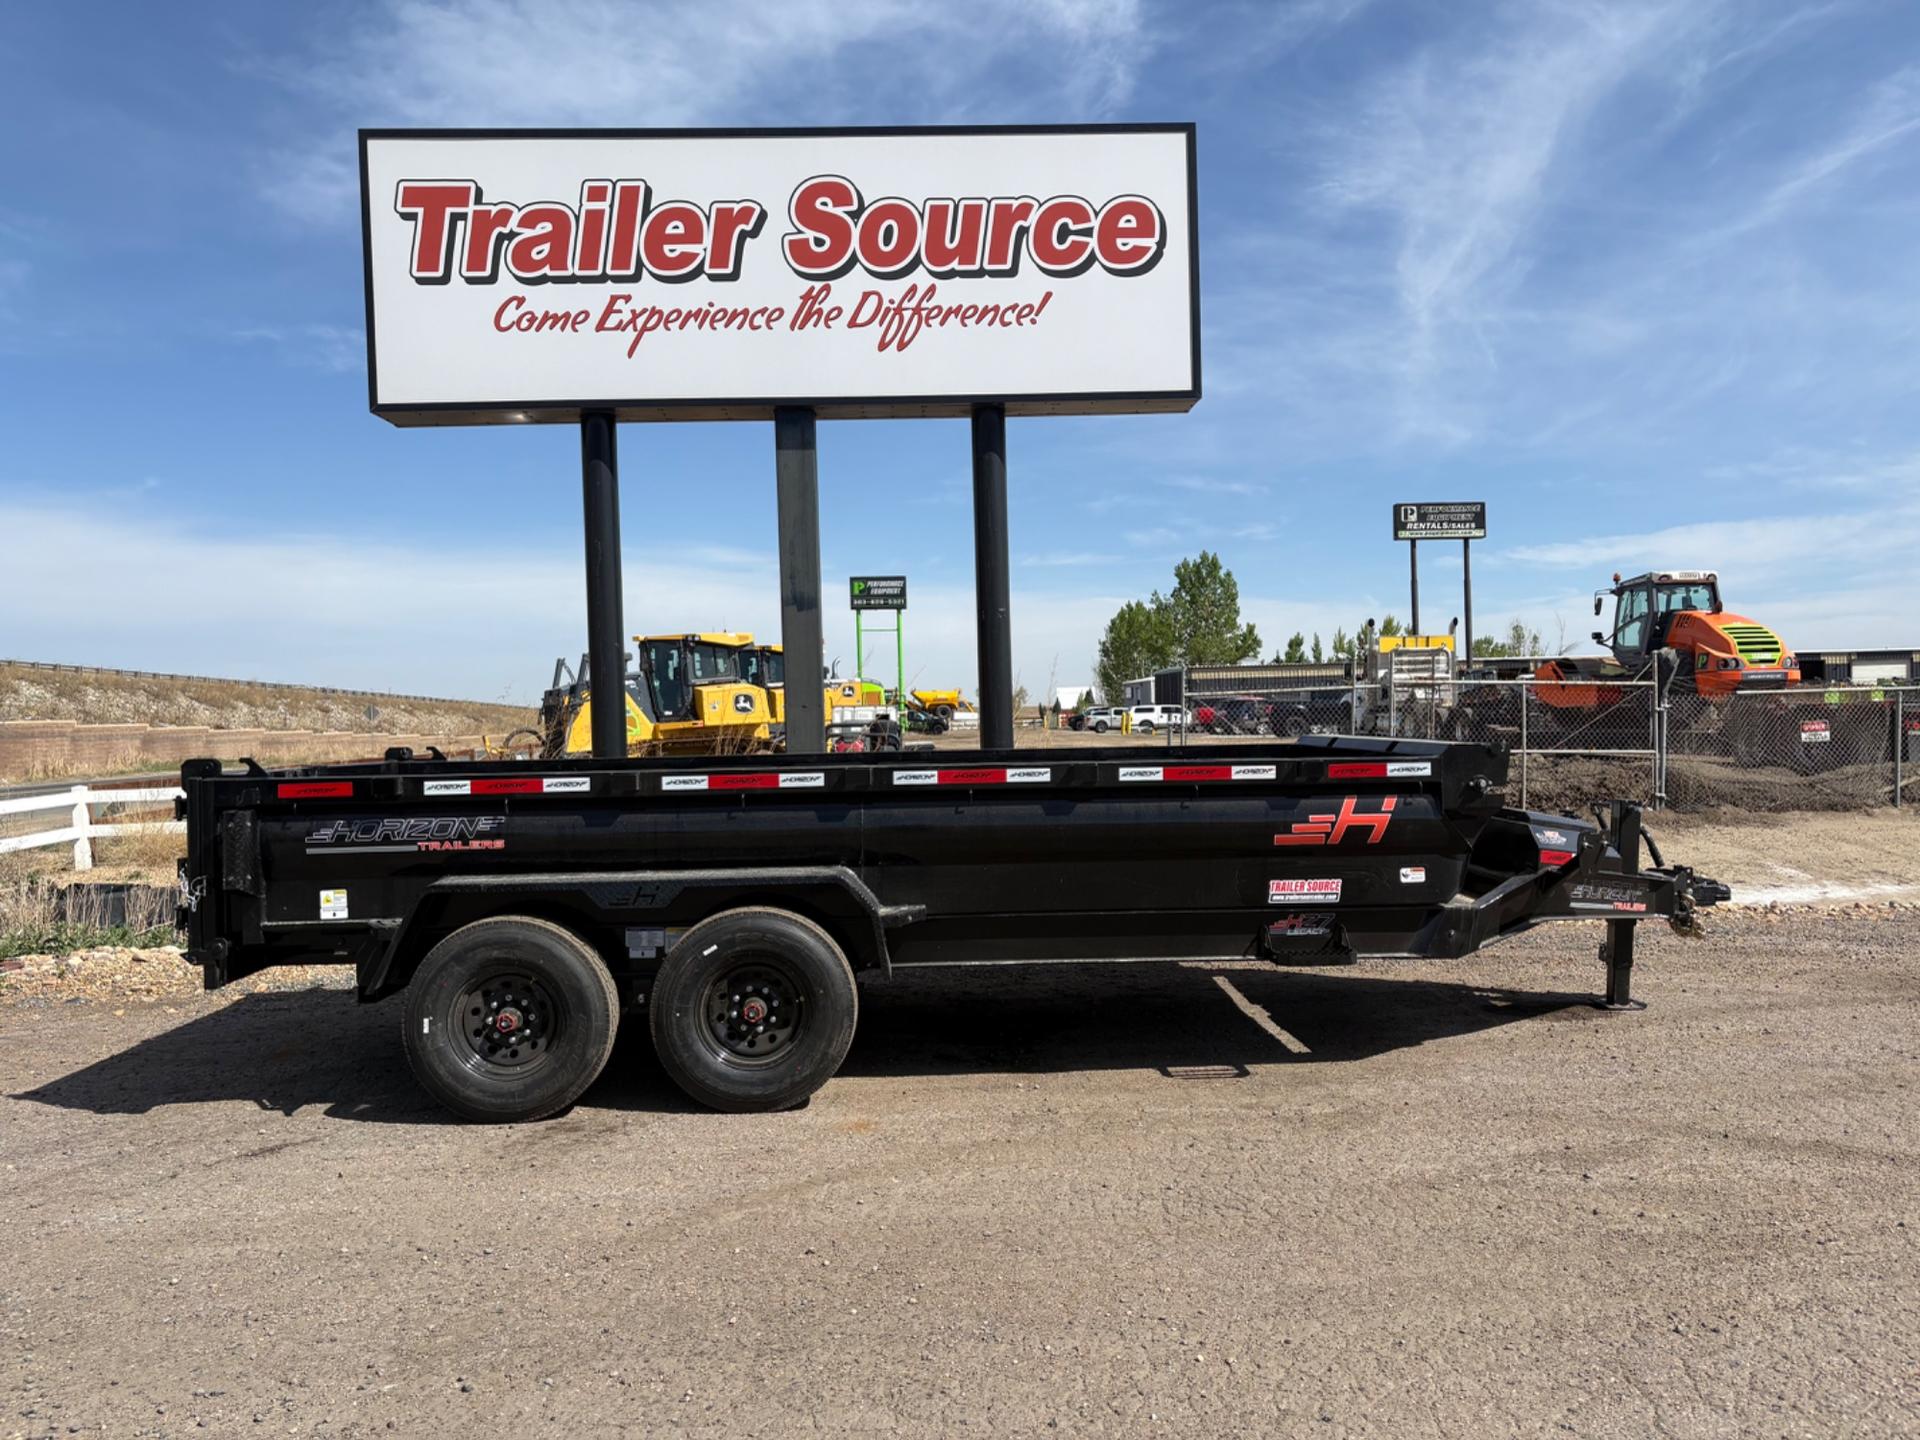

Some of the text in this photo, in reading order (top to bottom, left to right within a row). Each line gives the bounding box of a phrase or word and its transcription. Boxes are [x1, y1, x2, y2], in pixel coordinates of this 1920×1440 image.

[394, 174, 1167, 286] Trailer Source
[493, 283, 1053, 359] Come Experience the Difference!
[1406, 522, 1476, 530] RENTALS/SALES
[426, 783, 467, 791] HORIZON
[546, 781, 587, 789] HORIZON
[305, 816, 505, 843] HORIZON
[417, 839, 505, 850] TRAILERS
[1270, 879, 1341, 892] TRAILER SOURCE
[1613, 902, 1646, 911] TRAILERS
